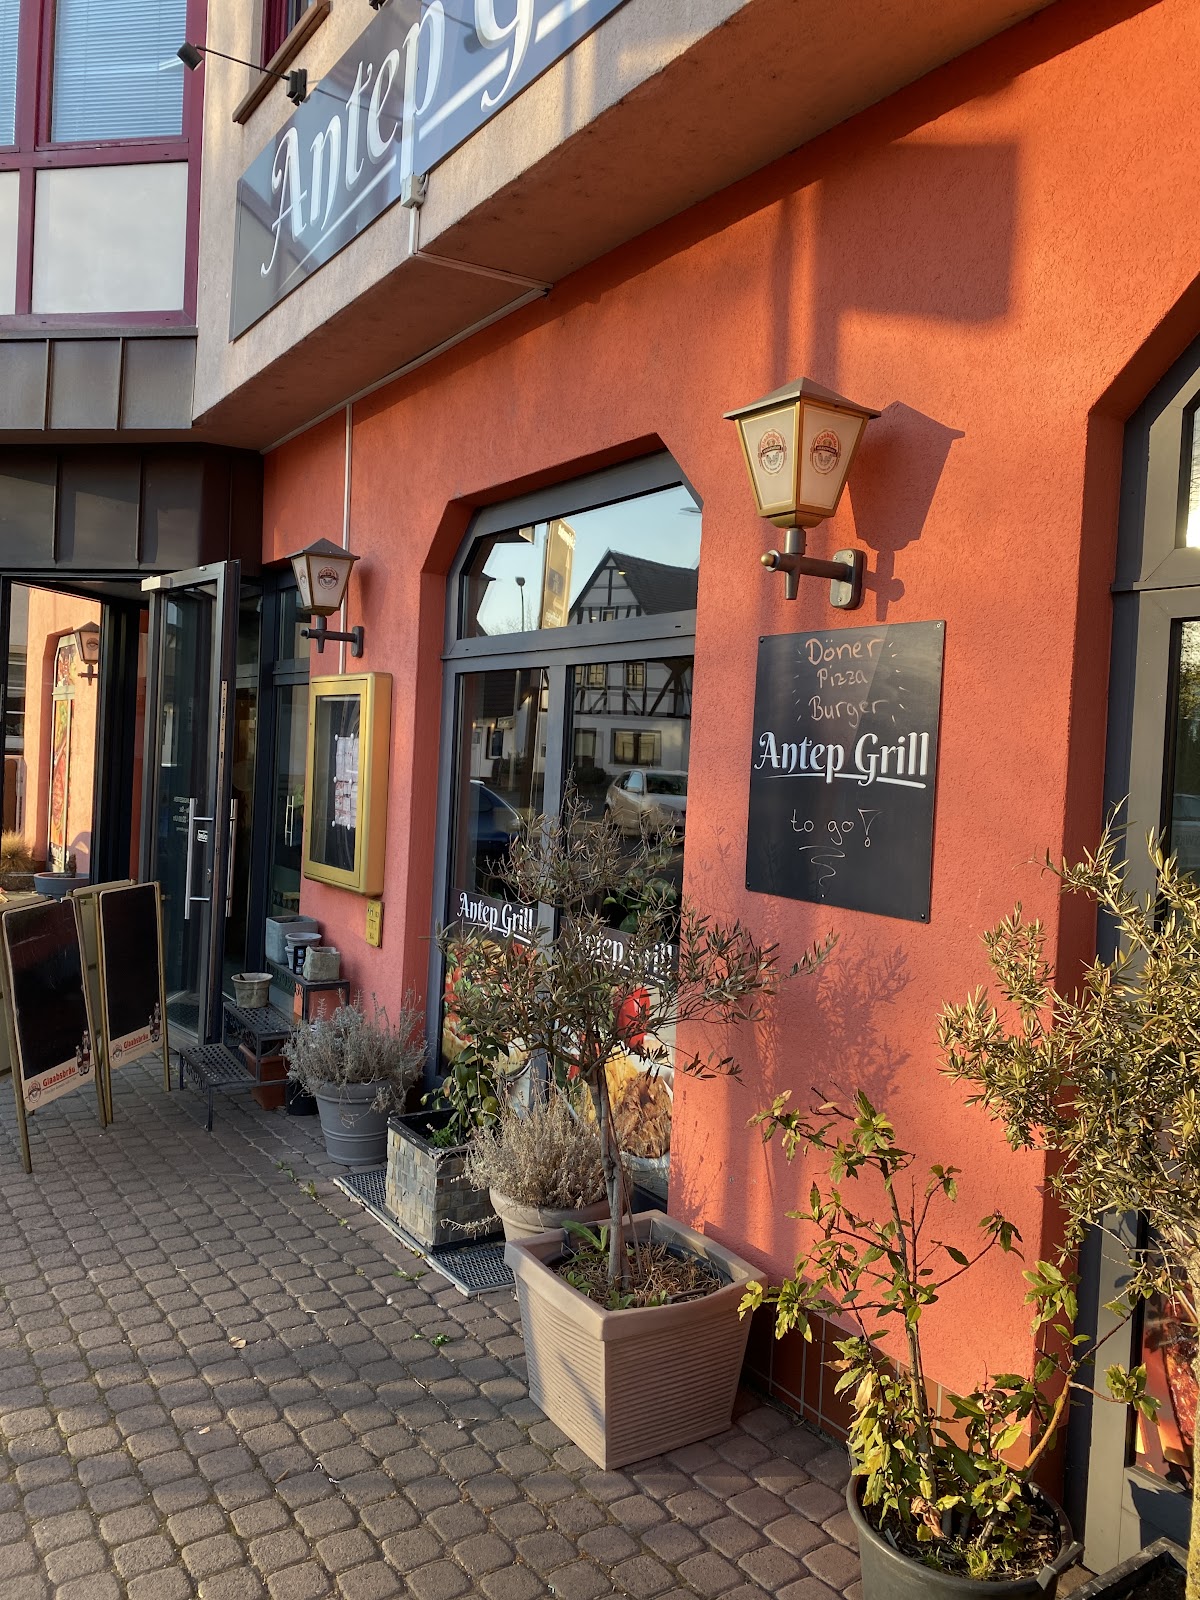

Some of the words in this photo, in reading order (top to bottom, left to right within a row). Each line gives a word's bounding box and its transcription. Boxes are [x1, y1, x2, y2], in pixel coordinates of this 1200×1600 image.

[260, 0, 445, 277] Antep
[805, 637, 884, 665] Döner
[816, 665, 868, 689] Pizza
[808, 695, 889, 728] Burger
[754, 732, 845, 784] Antep
[854, 732, 930, 786] Grill
[790, 809, 814, 833] to
[456, 892, 499, 933] Antep
[501, 903, 534, 938] Grill
[42, 1065, 76, 1087] Glaabsbräu
